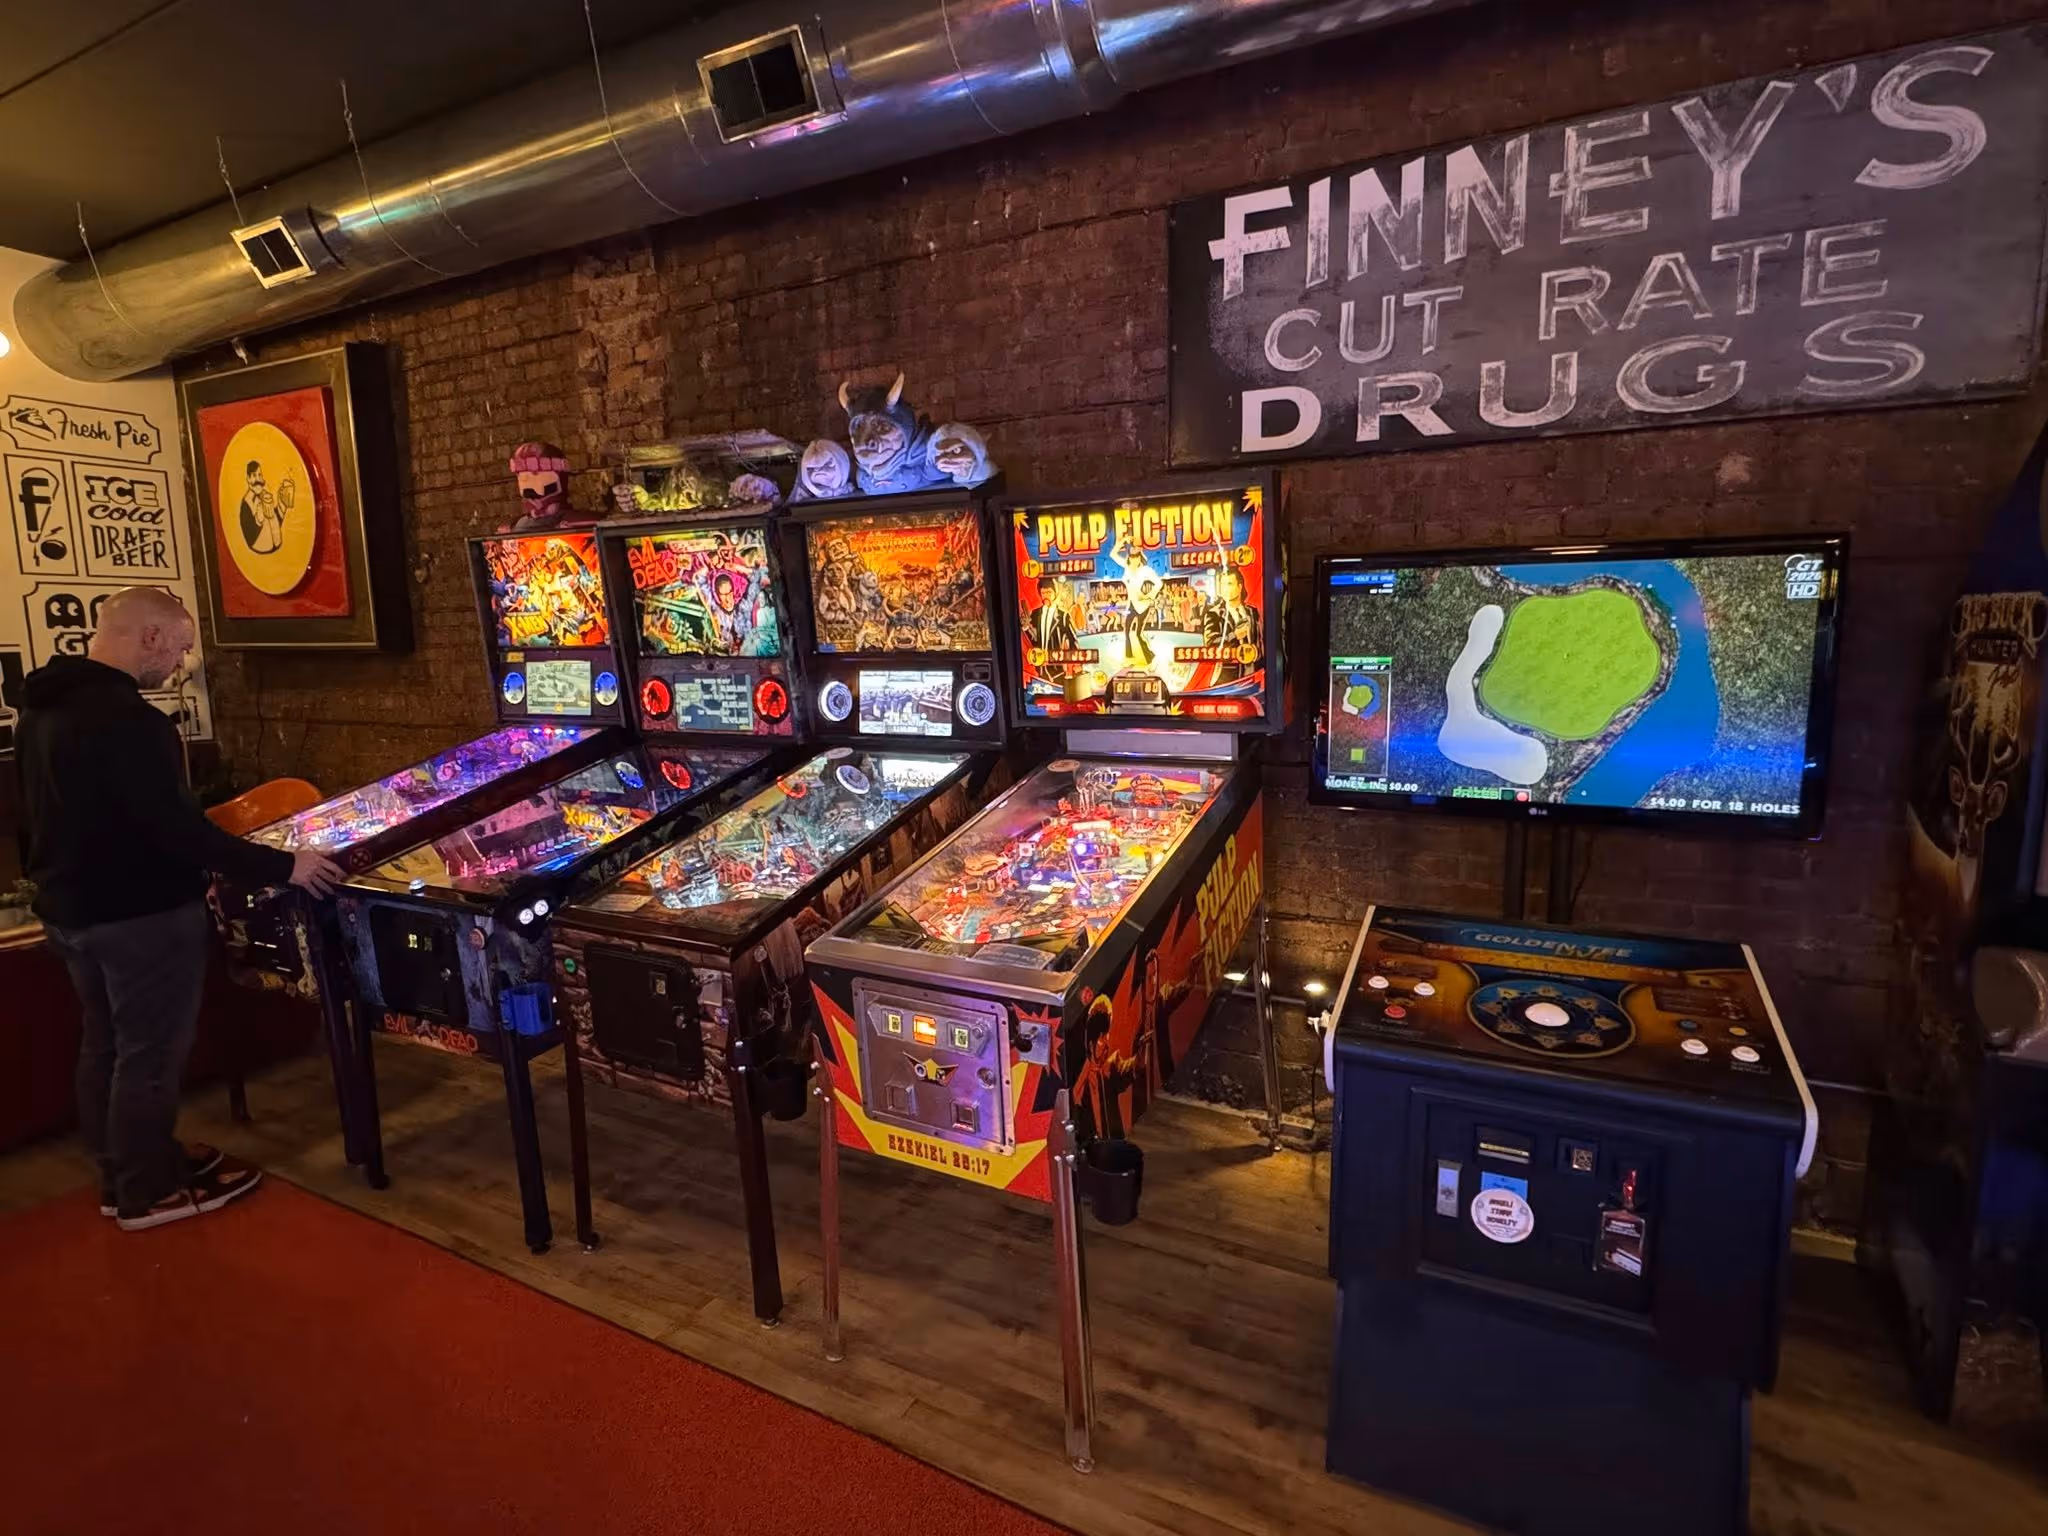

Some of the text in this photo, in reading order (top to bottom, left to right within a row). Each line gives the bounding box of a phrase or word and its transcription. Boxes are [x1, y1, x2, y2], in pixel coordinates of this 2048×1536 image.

[1207, 45, 1996, 301] FINNEY'S
[1263, 218, 1889, 372] CUT RATE
[1240, 310, 1926, 453] DRUGS
[47, 408, 153, 449] Fresh Pie
[84, 475, 160, 508] ICE
[90, 524, 166, 559] DRAFT
[1037, 501, 1233, 557] PULP FICTION
[112, 541, 170, 569] BEER
[627, 536, 662, 569] EVIL
[1796, 560, 1824, 571] GT
[633, 558, 677, 589] DEAD
[1790, 584, 1818, 597] HD
[504, 615, 549, 639] X-MEN
[1970, 638, 2019, 657] HUNTER
[1389, 782, 1418, 792] $0.00
[1453, 786, 1499, 799] PRIZES
[1650, 798, 1801, 814] $4.00 FOR 18 HOLES
[1196, 833, 1237, 947] PULP
[1203, 849, 1261, 999] FICTION
[1474, 932, 1575, 957] GOLDEN
[439, 1024, 479, 1054] DEAD
[887, 1133, 947, 1165] EZEKIEL
